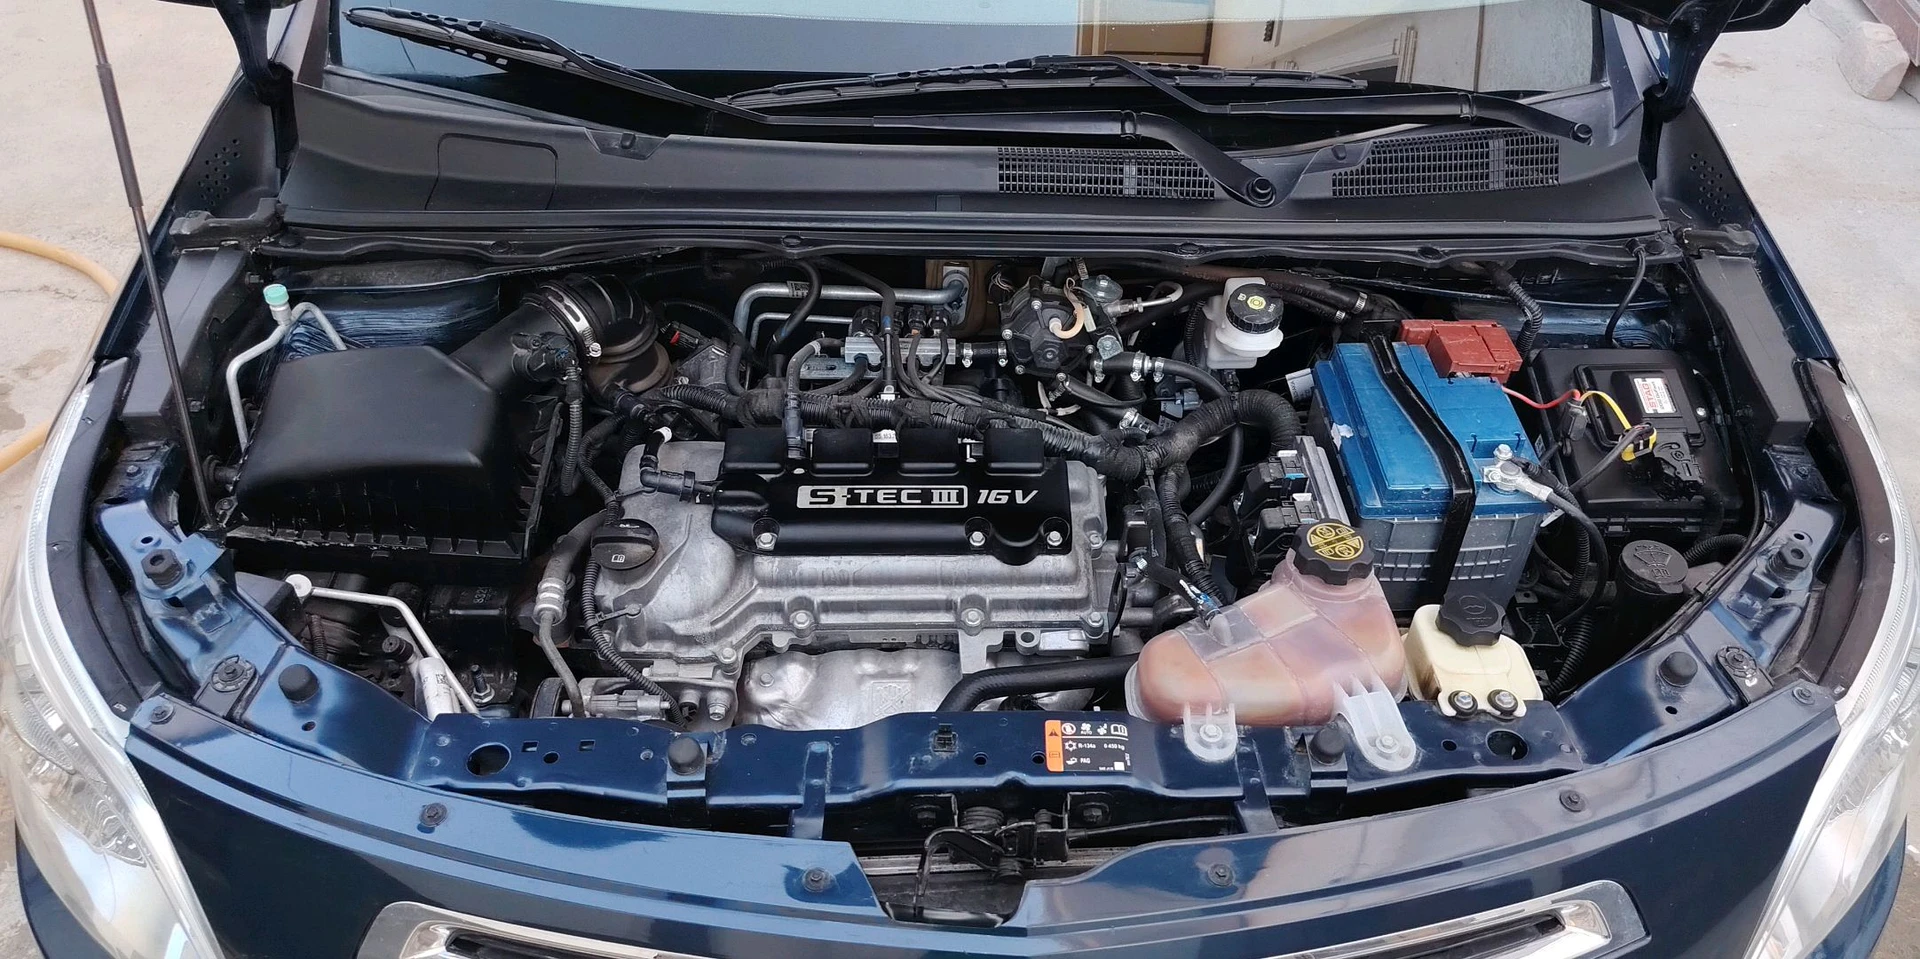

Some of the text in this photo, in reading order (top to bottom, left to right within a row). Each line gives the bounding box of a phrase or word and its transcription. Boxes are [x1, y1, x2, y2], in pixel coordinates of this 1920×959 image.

[1642, 383, 1656, 408] STAG
[809, 488, 1039, 505] S-TEC III 16V
